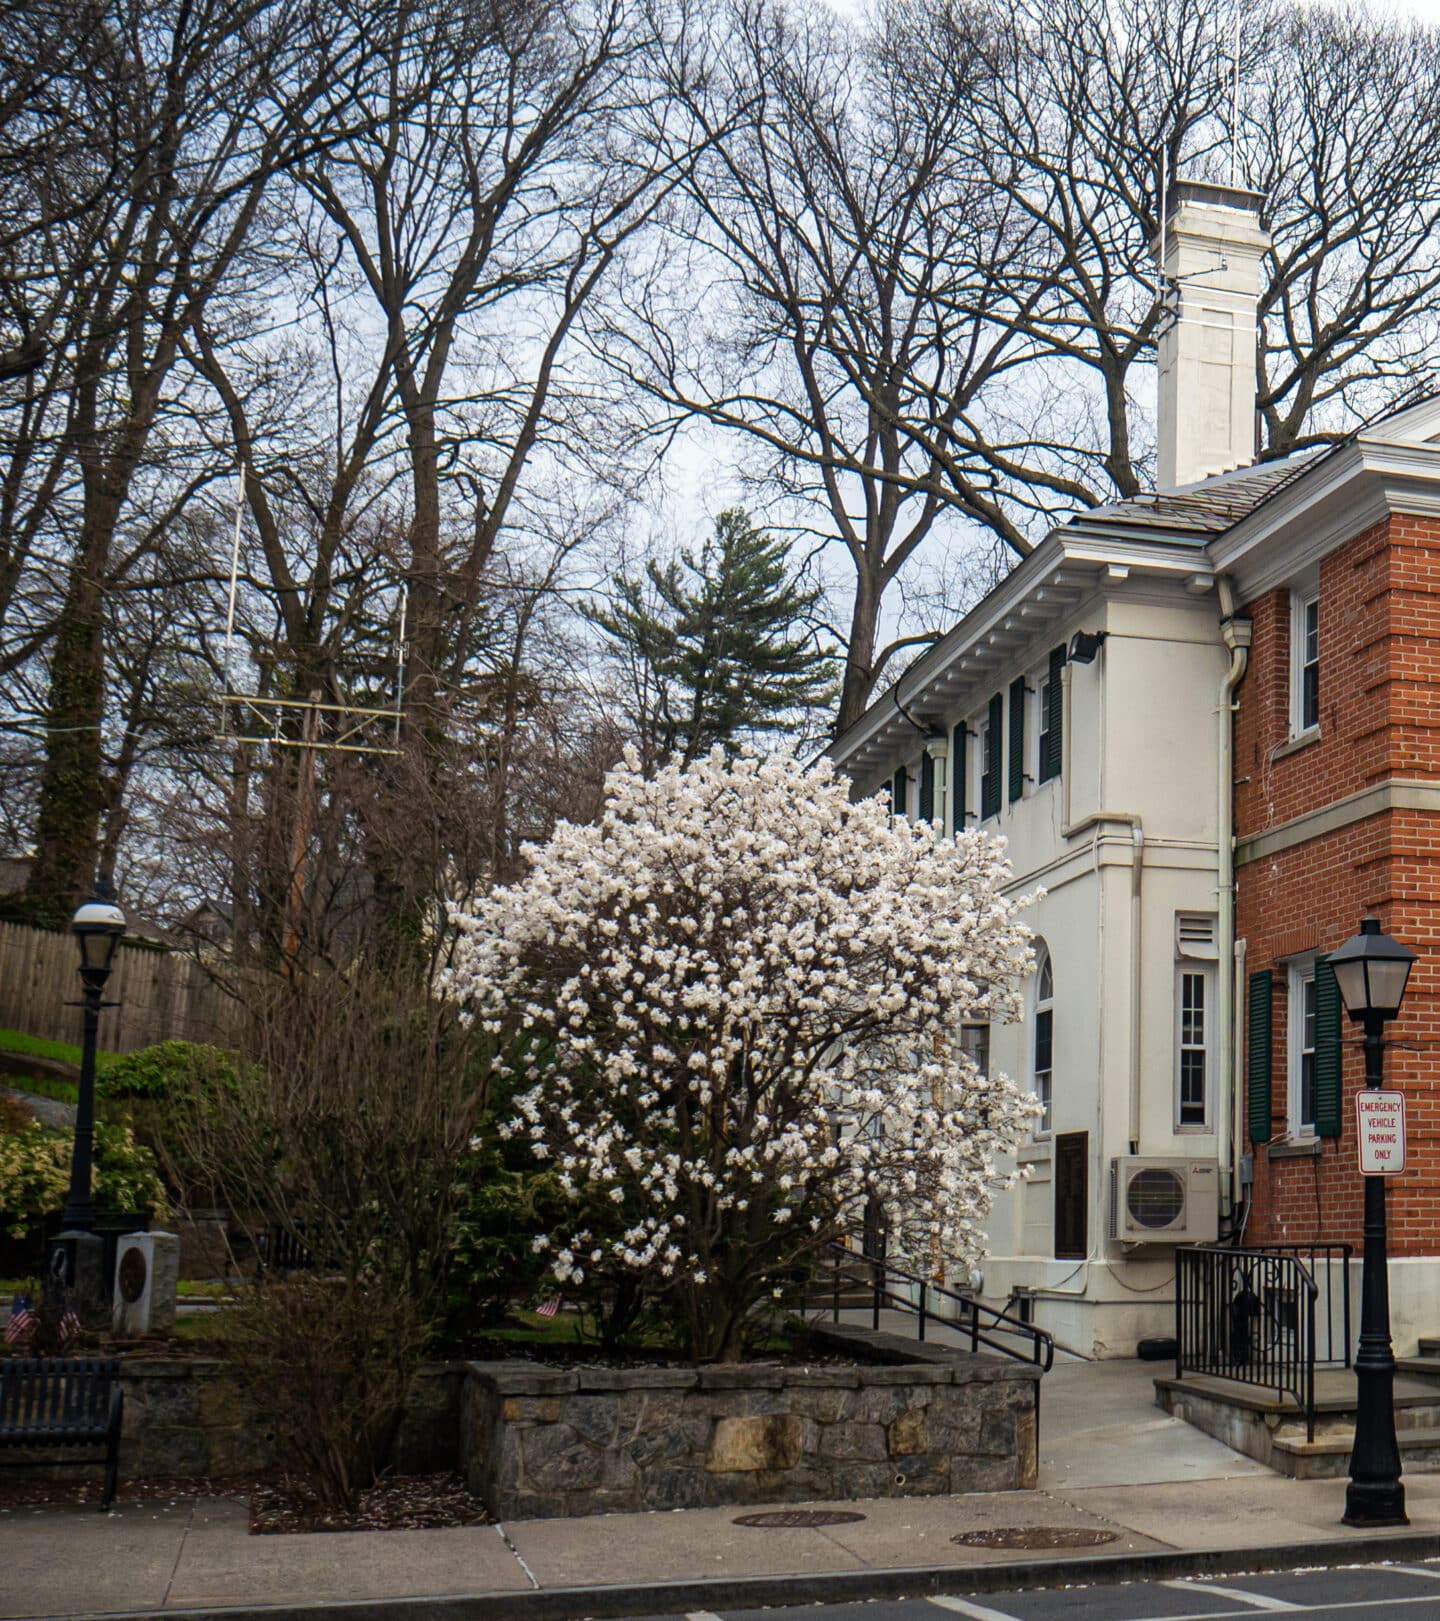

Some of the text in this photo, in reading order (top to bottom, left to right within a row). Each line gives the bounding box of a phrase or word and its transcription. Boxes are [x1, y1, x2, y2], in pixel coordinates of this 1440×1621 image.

[1360, 1102, 1401, 1112] EMERGENCY
[1368, 1118, 1396, 1128] VEHICLE
[1368, 1134, 1397, 1144] PARKING
[1374, 1150, 1391, 1160] ONLY
